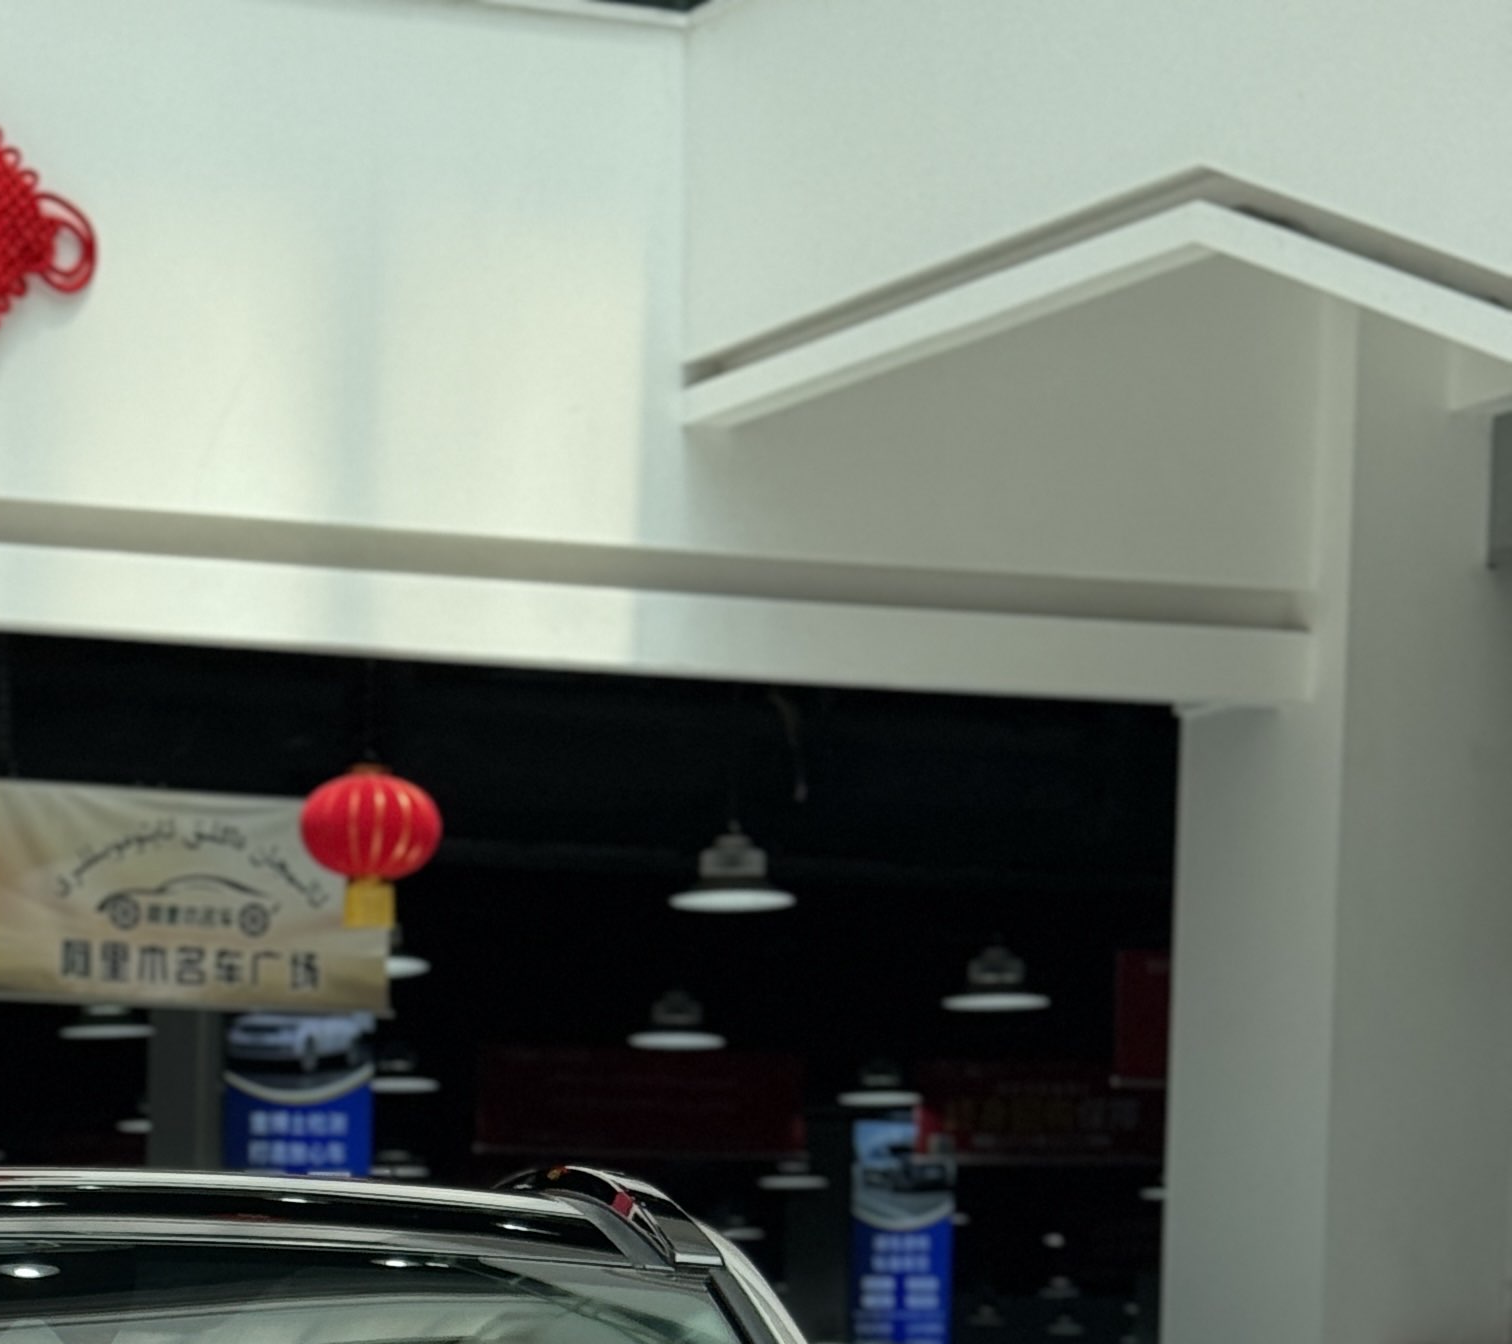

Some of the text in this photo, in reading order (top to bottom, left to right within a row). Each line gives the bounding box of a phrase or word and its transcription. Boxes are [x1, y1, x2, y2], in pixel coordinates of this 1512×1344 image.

[61, 938, 321, 989] 阿里木名车广场
